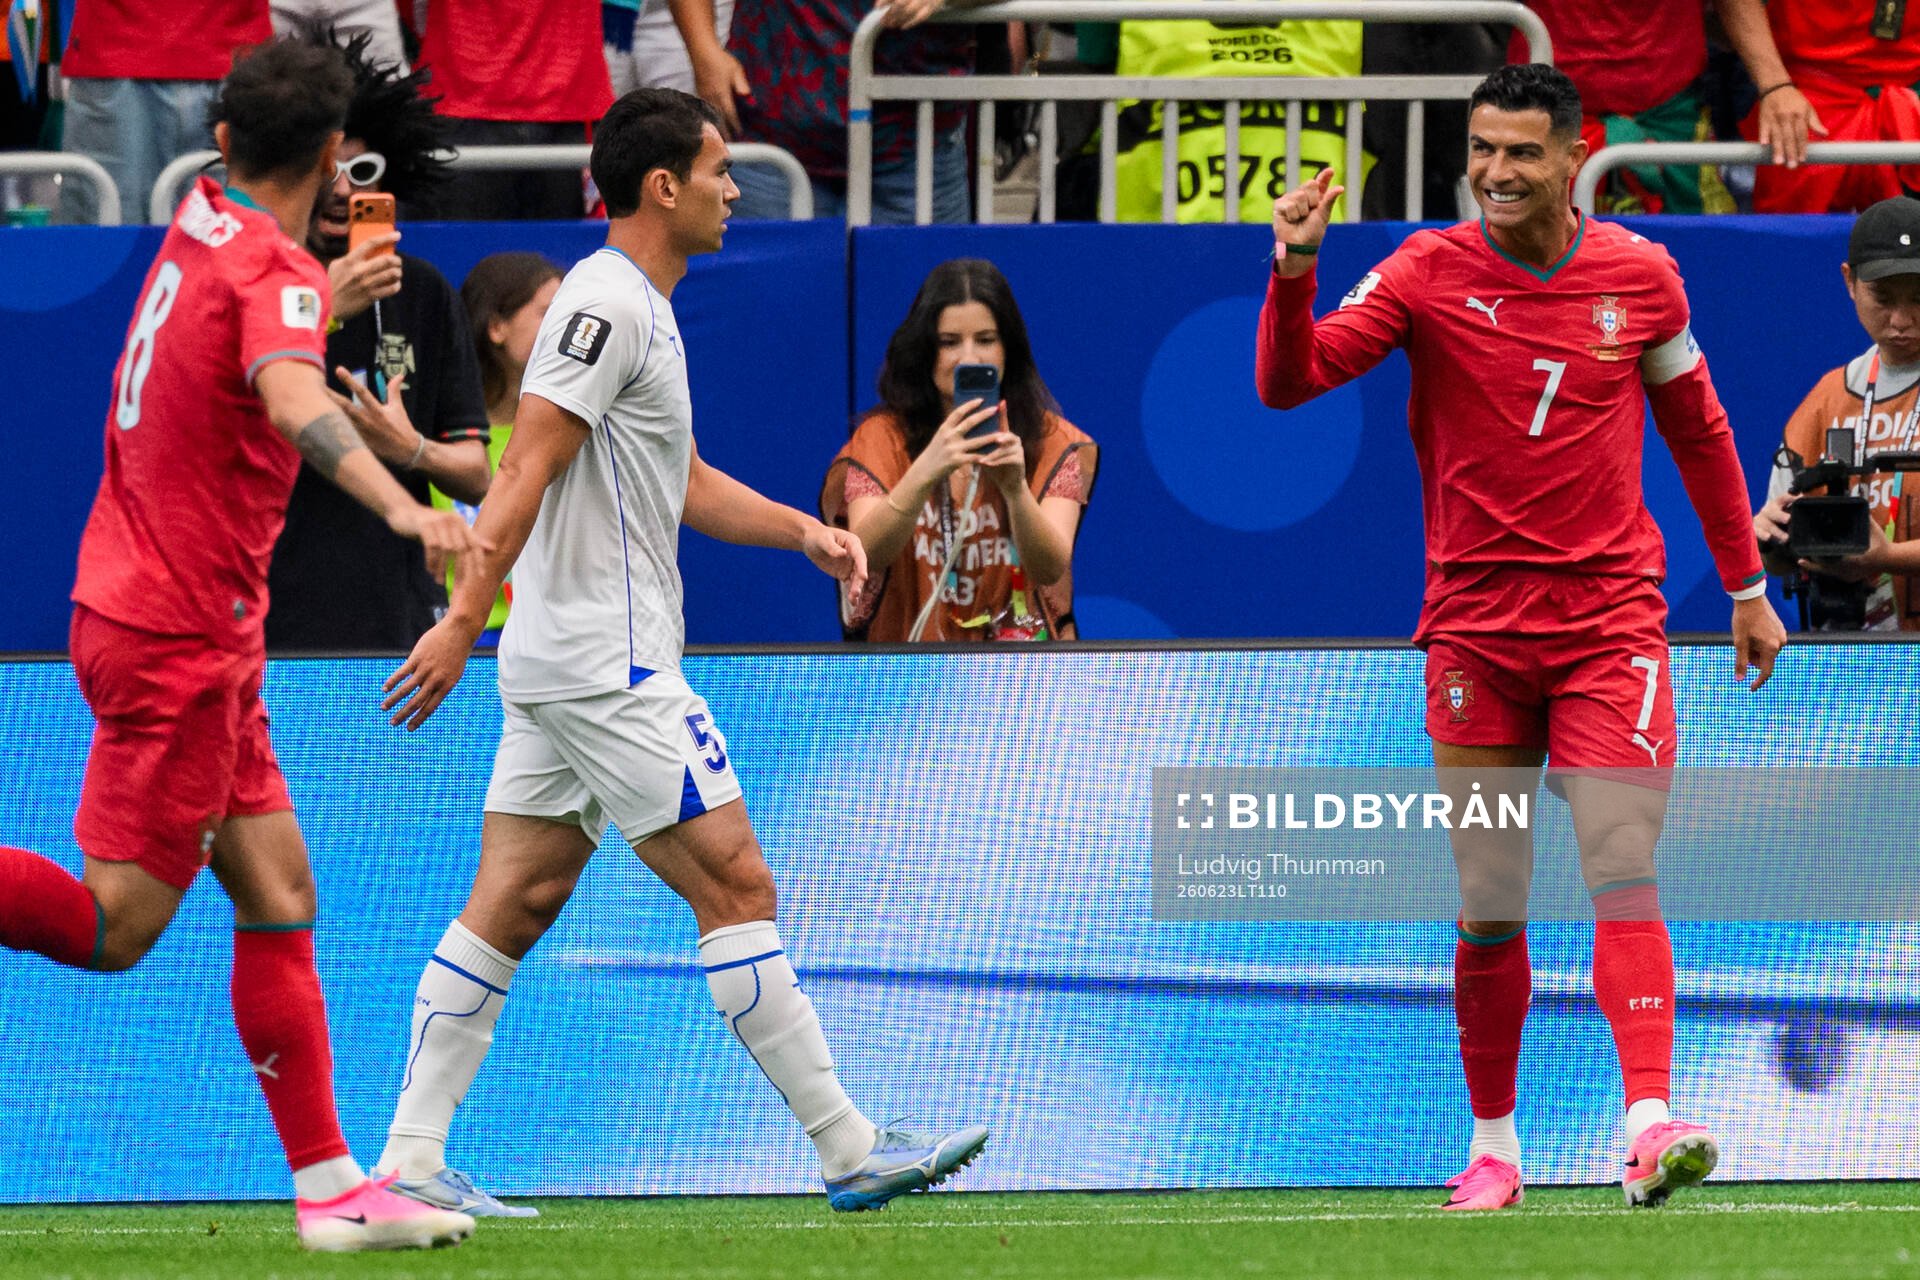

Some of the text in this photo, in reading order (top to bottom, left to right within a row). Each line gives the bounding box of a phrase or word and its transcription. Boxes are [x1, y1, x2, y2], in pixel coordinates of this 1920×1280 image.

[1208, 34, 1261, 46] WORLD
[1210, 47, 1293, 64] 2026
[116, 261, 183, 431] 8
[1528, 358, 1567, 436] 7
[1631, 656, 1660, 730] 7
[684, 713, 727, 774] 5
